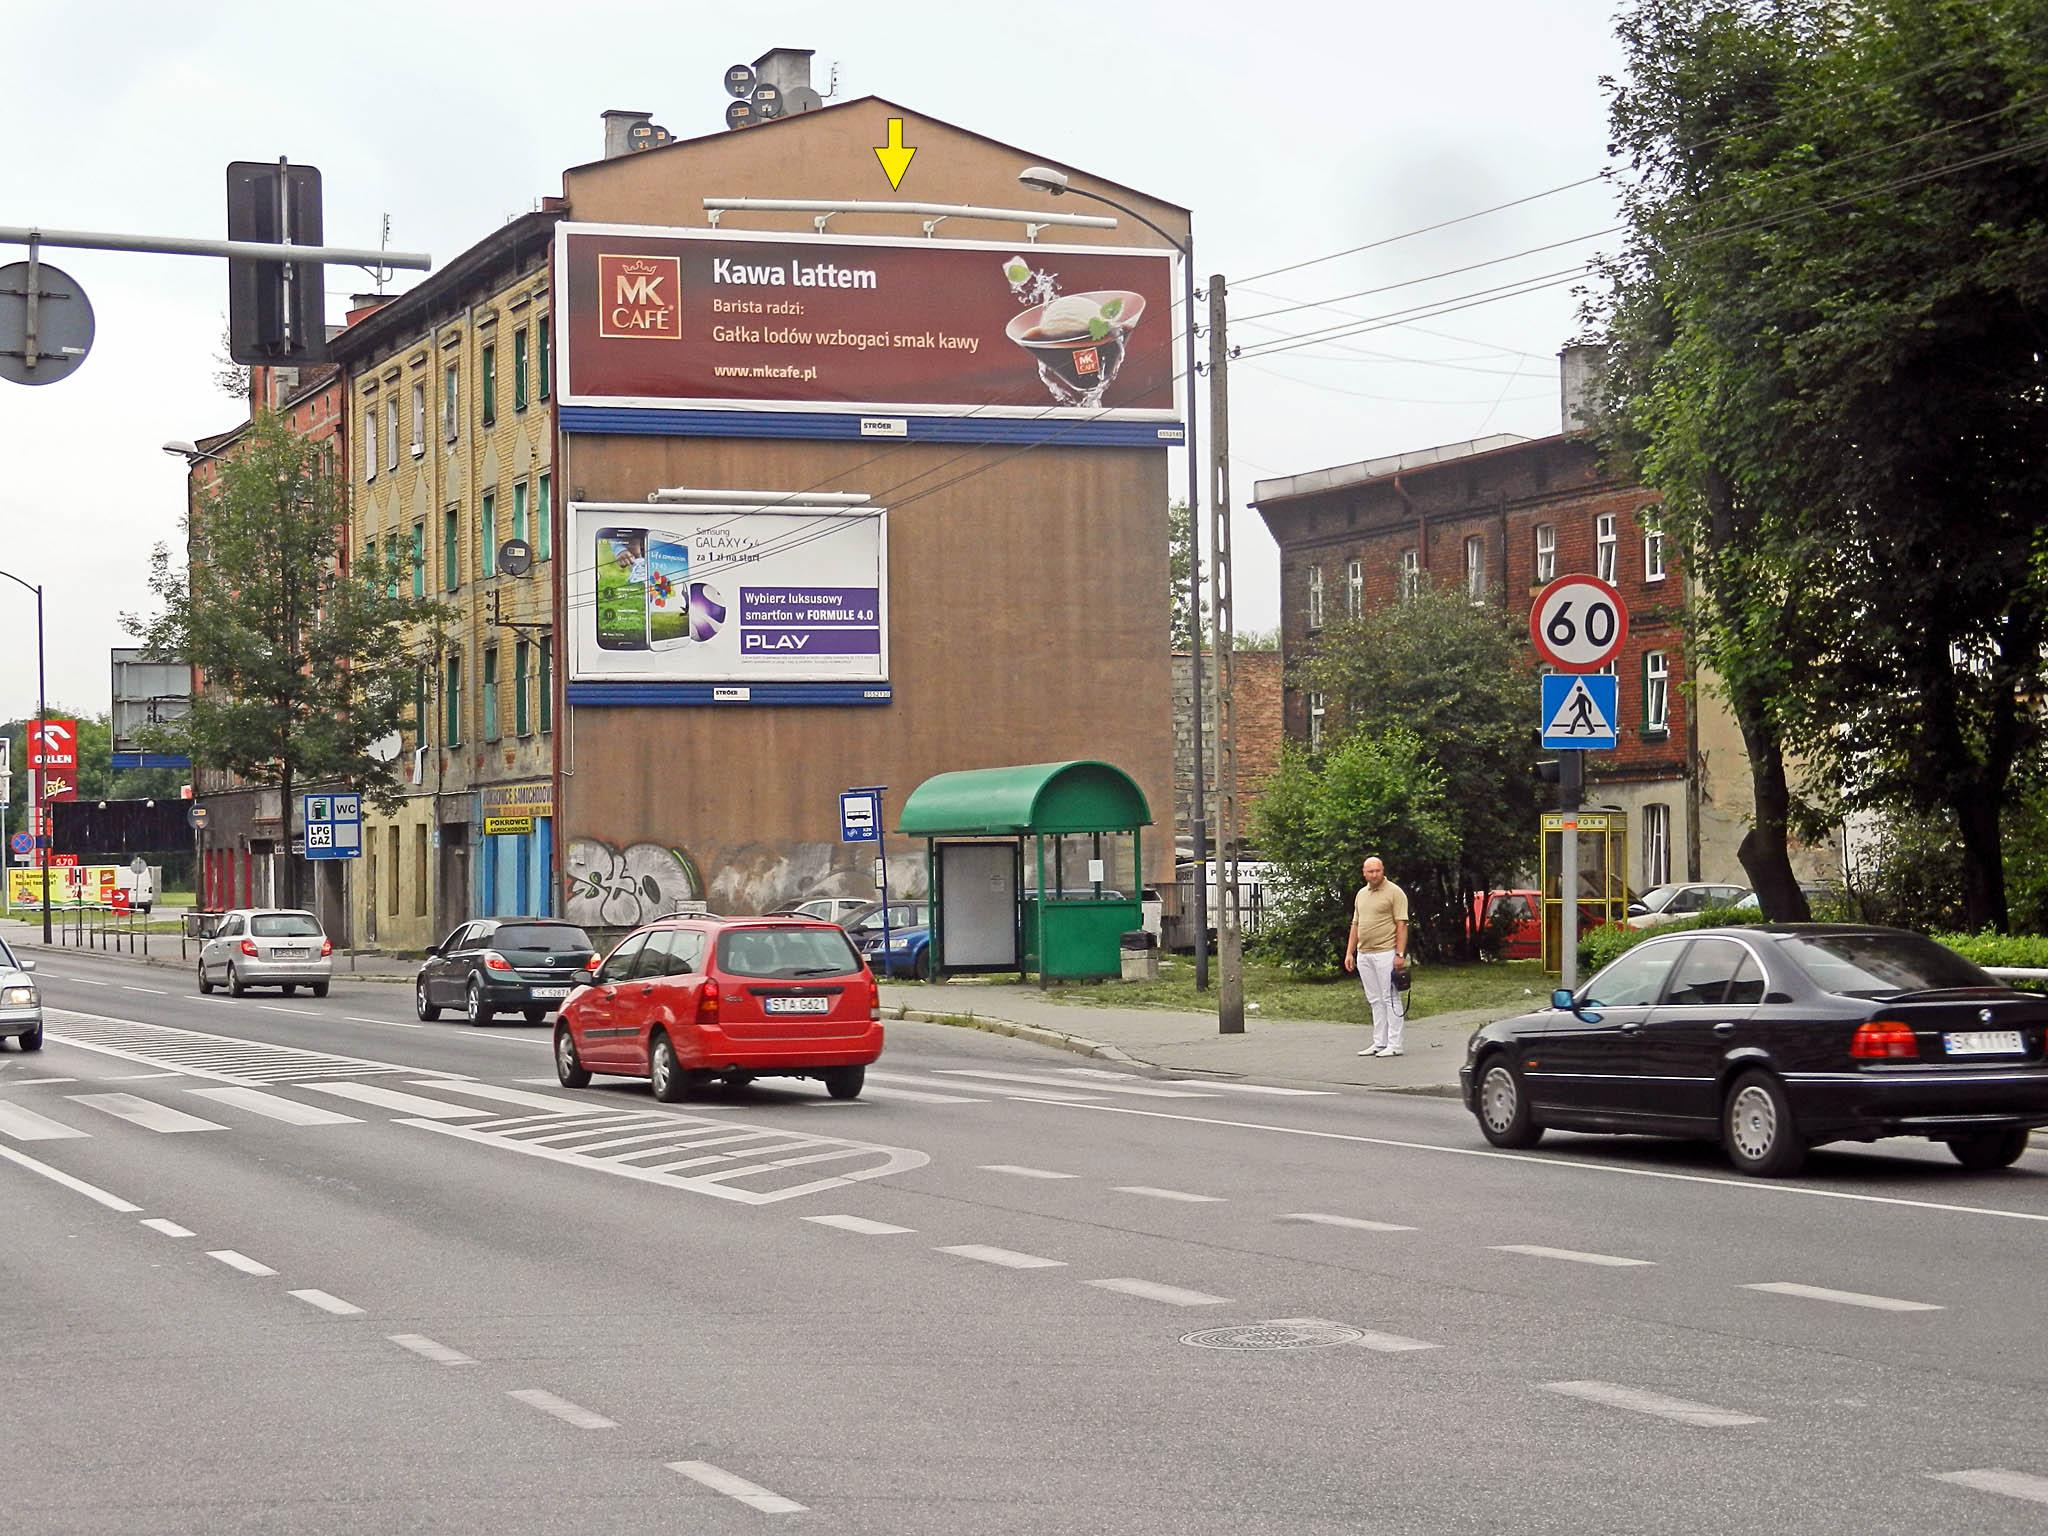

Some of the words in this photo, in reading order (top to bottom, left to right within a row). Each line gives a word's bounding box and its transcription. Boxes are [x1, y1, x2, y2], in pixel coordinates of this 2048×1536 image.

[713, 258, 785, 285] Kawa
[793, 260, 877, 289] lattem
[617, 275, 664, 305] MK
[713, 299, 763, 313] Barista
[766, 302, 804, 315] radzi:
[612, 307, 669, 329] CAFÉ
[713, 326, 760, 344] Gałka
[764, 327, 812, 345] lodów
[816, 329, 890, 351] wzbogaci
[893, 331, 936, 348] smak
[939, 332, 979, 353] kawy
[714, 365, 818, 381] www.mkcafe.pl
[696, 527, 730, 537] Samsung
[696, 537, 740, 548] GALAXY
[709, 551, 713, 561] 1
[745, 592, 786, 606] Wybierz
[789, 593, 843, 606] luksusowy
[745, 609, 793, 620] smartfon
[796, 611, 804, 620] w
[807, 609, 855, 620] FORMULE
[857, 609, 874, 620] 4.0
[1547, 601, 1615, 647] 60
[746, 635, 810, 649] PLAY
[336, 804, 357, 814] WC
[490, 818, 529, 826] POKROWCE
[310, 826, 330, 836] LPG
[310, 836, 331, 846] GAZ
[772, 998, 798, 1010] STA
